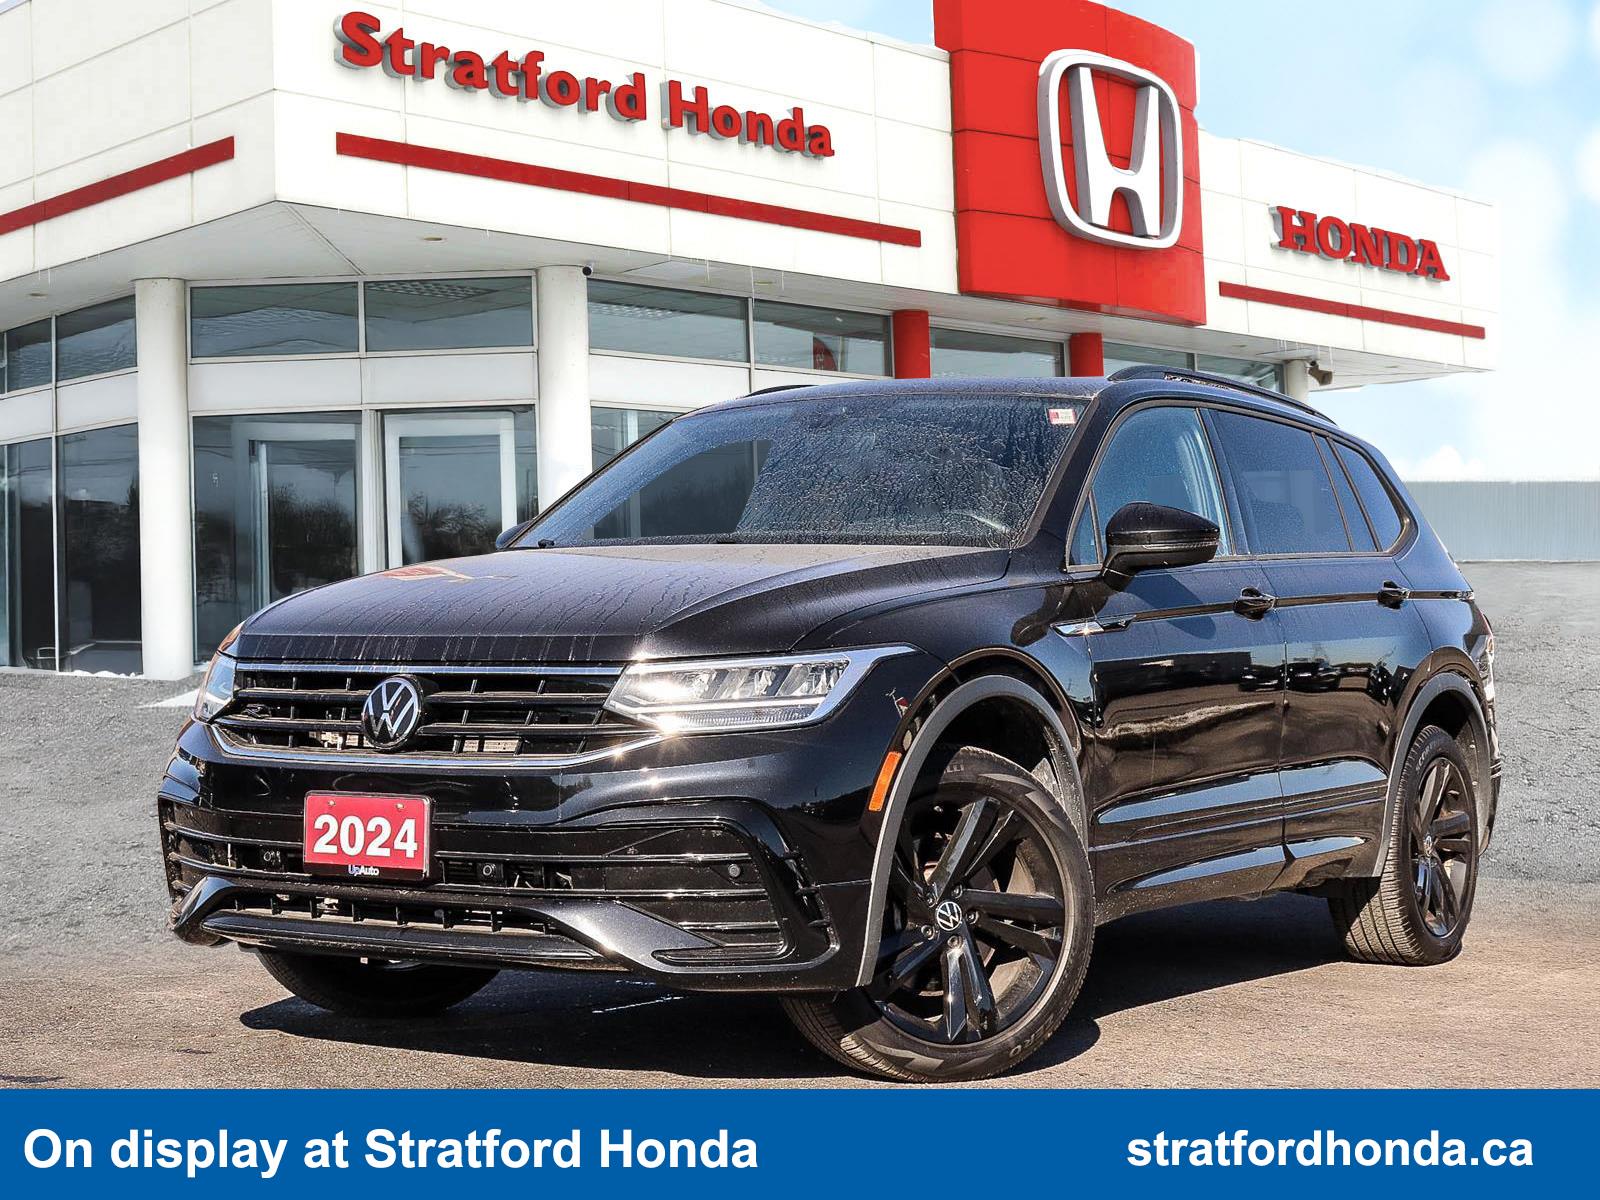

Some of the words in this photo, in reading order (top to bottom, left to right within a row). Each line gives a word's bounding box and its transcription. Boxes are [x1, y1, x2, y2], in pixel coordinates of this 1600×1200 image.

[339, 11, 647, 121] Stratford
[664, 79, 835, 158] Honda
[1271, 205, 1450, 281] HONDA
[313, 814, 418, 858] 2024
[348, 864, 380, 877] UpAuto
